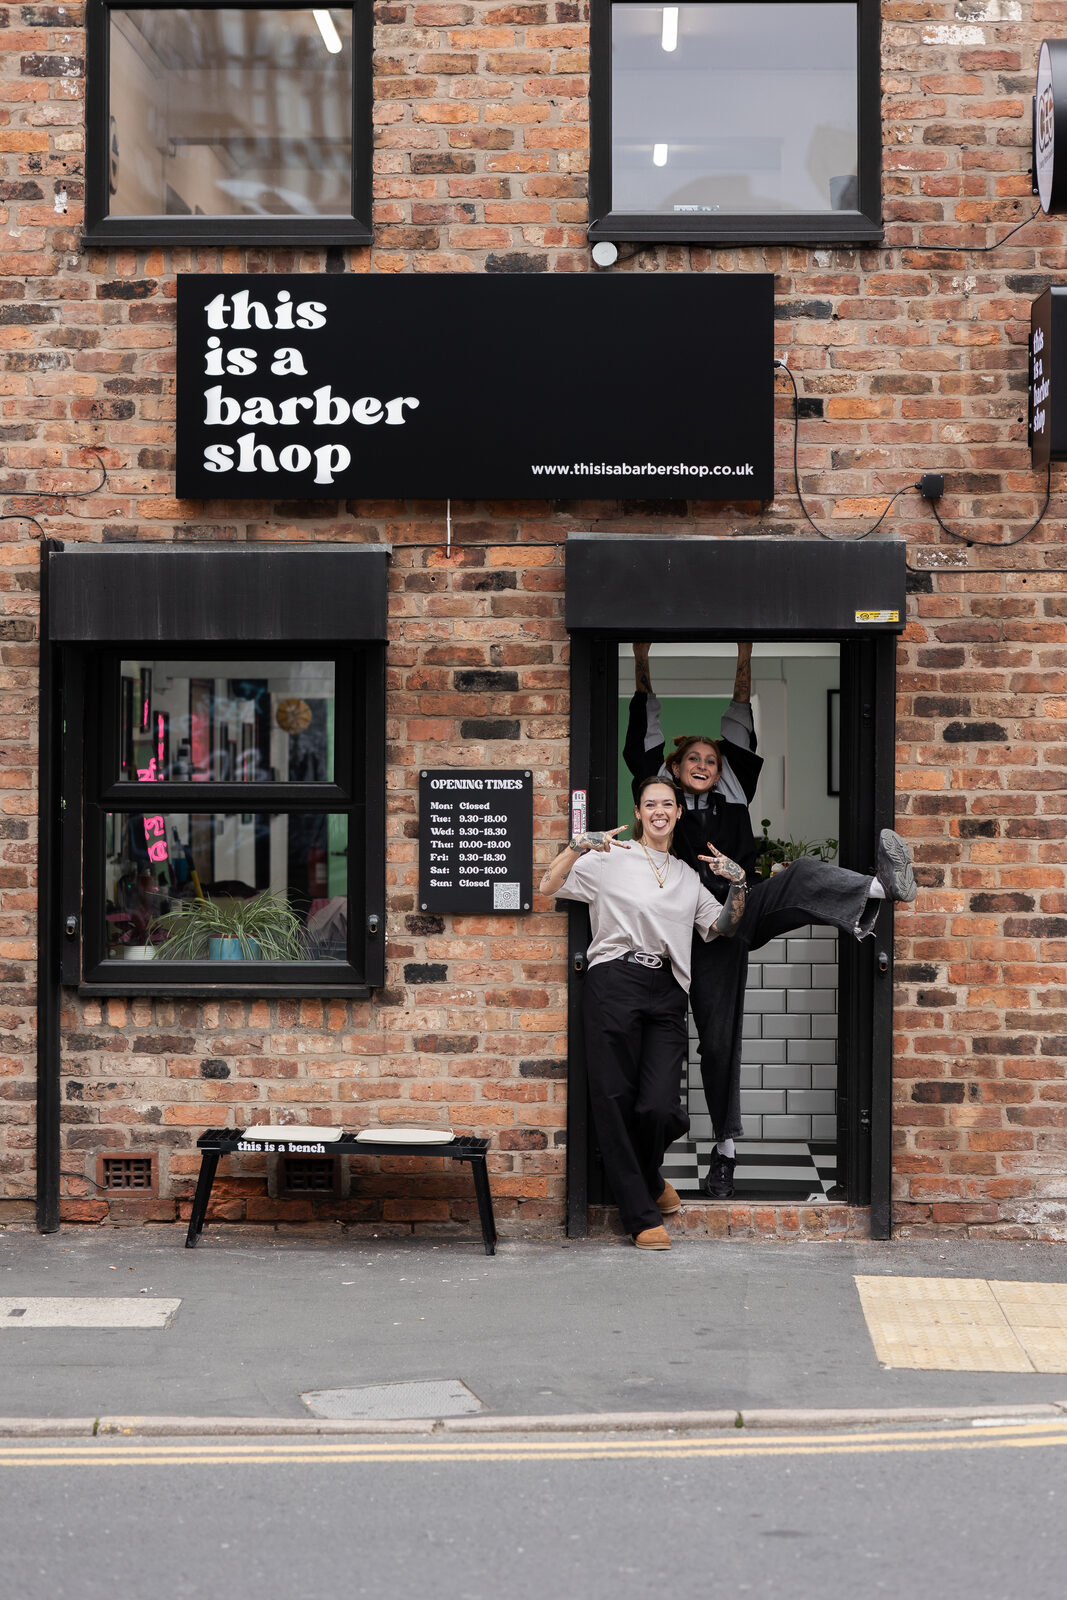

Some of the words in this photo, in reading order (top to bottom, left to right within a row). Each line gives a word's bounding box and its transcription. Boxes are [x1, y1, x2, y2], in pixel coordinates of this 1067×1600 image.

[204, 290, 327, 329] this
[205, 336, 257, 375] is
[271, 348, 308, 375] a
[204, 385, 419, 425] barber
[204, 433, 351, 484] shop
[532, 463, 753, 477] www.thisisabarbershop.co.uk
[431, 780, 483, 789] OPENING
[485, 780, 523, 789] TIMES
[430, 866, 449, 874] Sat:
[459, 879, 489, 887] Closed
[237, 1141, 262, 1152] this
[265, 1142, 275, 1152] is
[278, 1145, 285, 1153] a
[288, 1143, 325, 1154] bench
